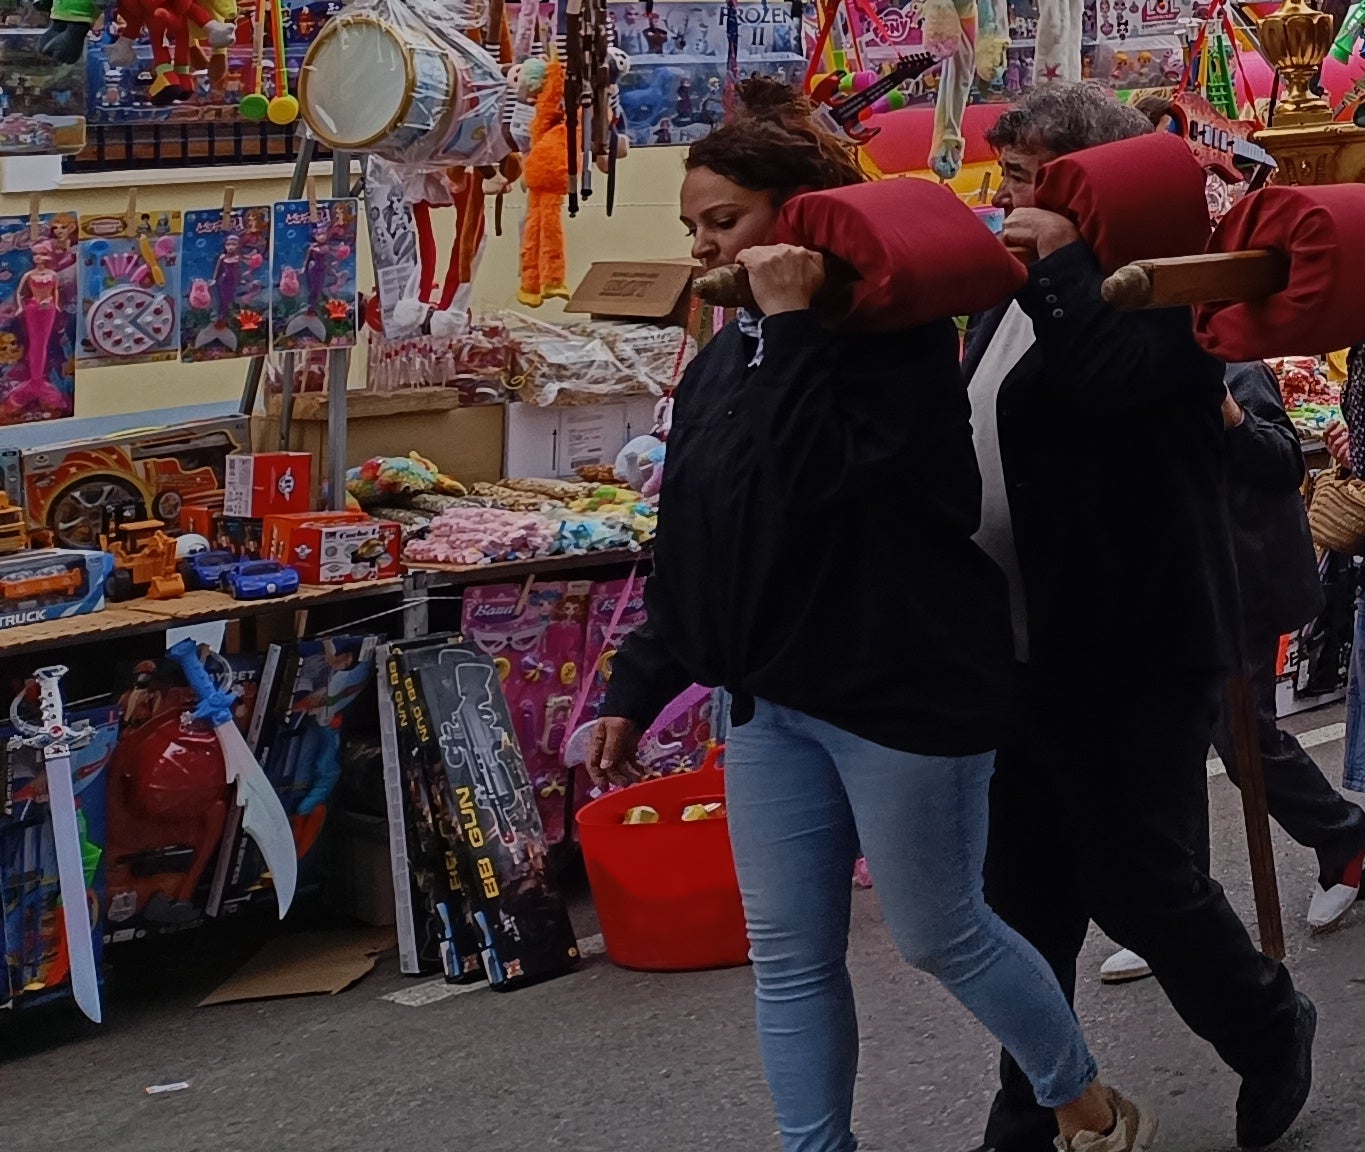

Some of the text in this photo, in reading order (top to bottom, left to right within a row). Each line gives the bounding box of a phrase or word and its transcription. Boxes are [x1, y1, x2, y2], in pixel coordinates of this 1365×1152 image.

[414, 705, 430, 743] GUN
[455, 785, 500, 900] BB GUN
